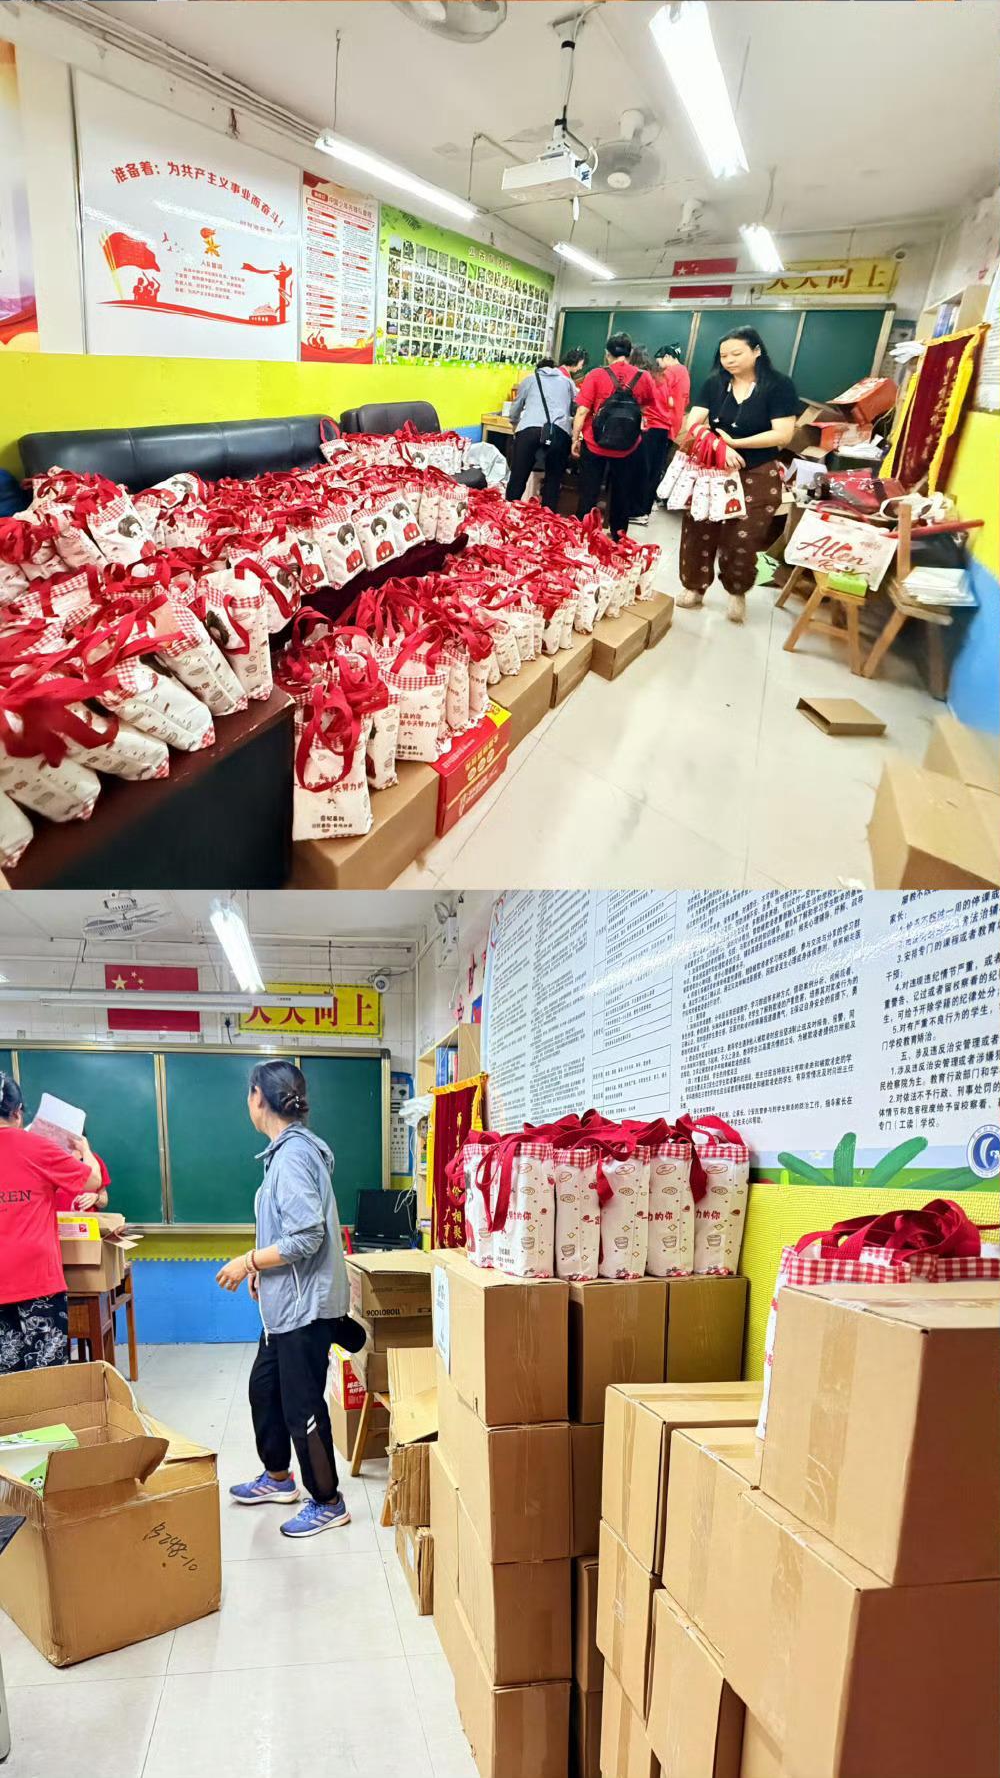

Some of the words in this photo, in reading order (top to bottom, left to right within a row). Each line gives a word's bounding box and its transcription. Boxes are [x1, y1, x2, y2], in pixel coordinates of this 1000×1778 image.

[796, 535, 867, 566] Allen
[878, 1098, 1000, 1117] 体情节和危害程度给予留校察看、
